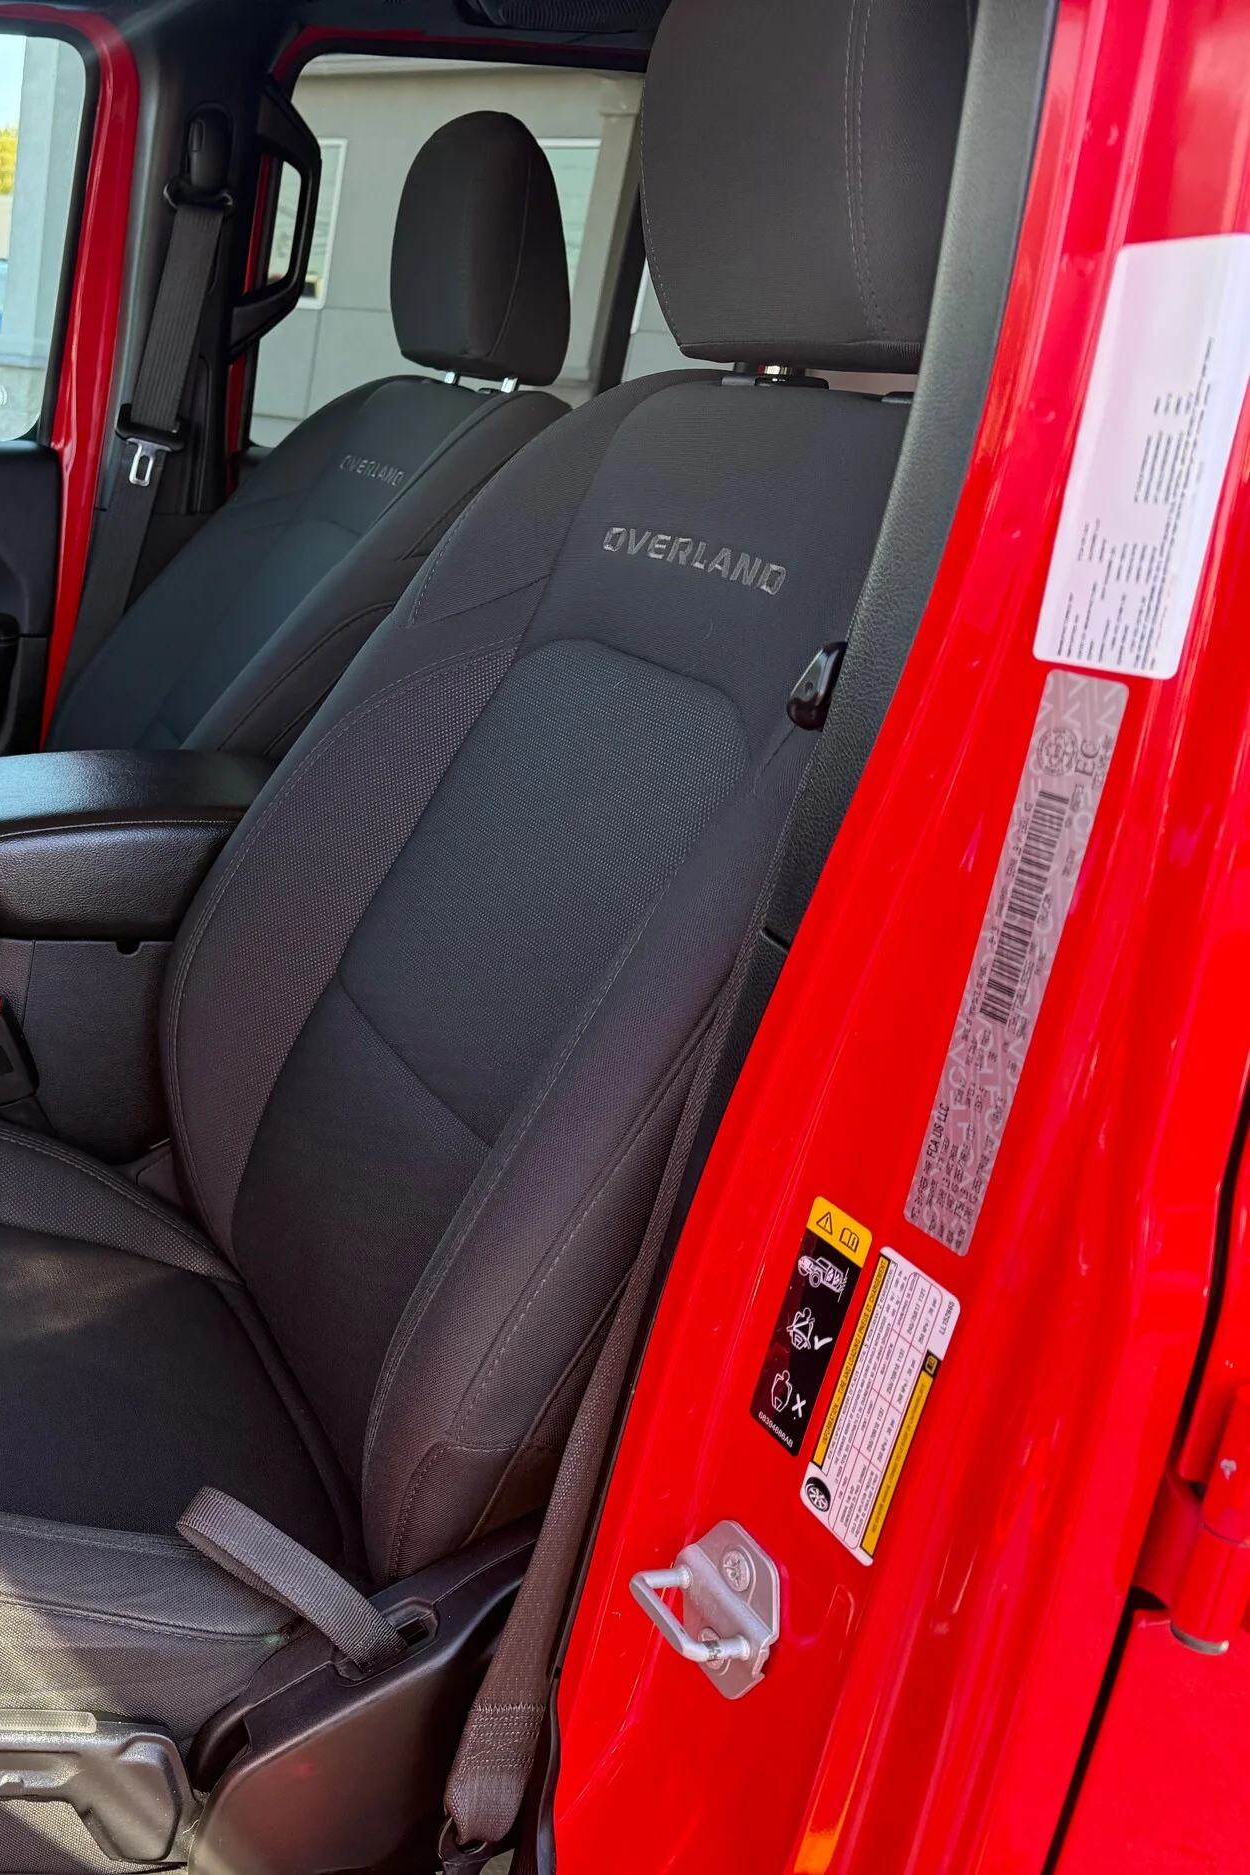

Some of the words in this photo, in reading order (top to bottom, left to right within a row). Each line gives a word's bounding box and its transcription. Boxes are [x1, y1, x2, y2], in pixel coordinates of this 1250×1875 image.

[339, 455, 405, 487] OVERLAND
[602, 525, 788, 597] OVERLAND
[935, 1100, 950, 1123] LLC
[931, 1121, 944, 1139] US
[925, 1137, 940, 1159] FCA
[867, 1258, 887, 1303] CHARGEMENT
[846, 1336, 861, 1368] LOADING
[842, 1363, 852, 1381] AND
[837, 1378, 847, 1396] TIRE
[820, 1401, 839, 1446] INFORMATION
